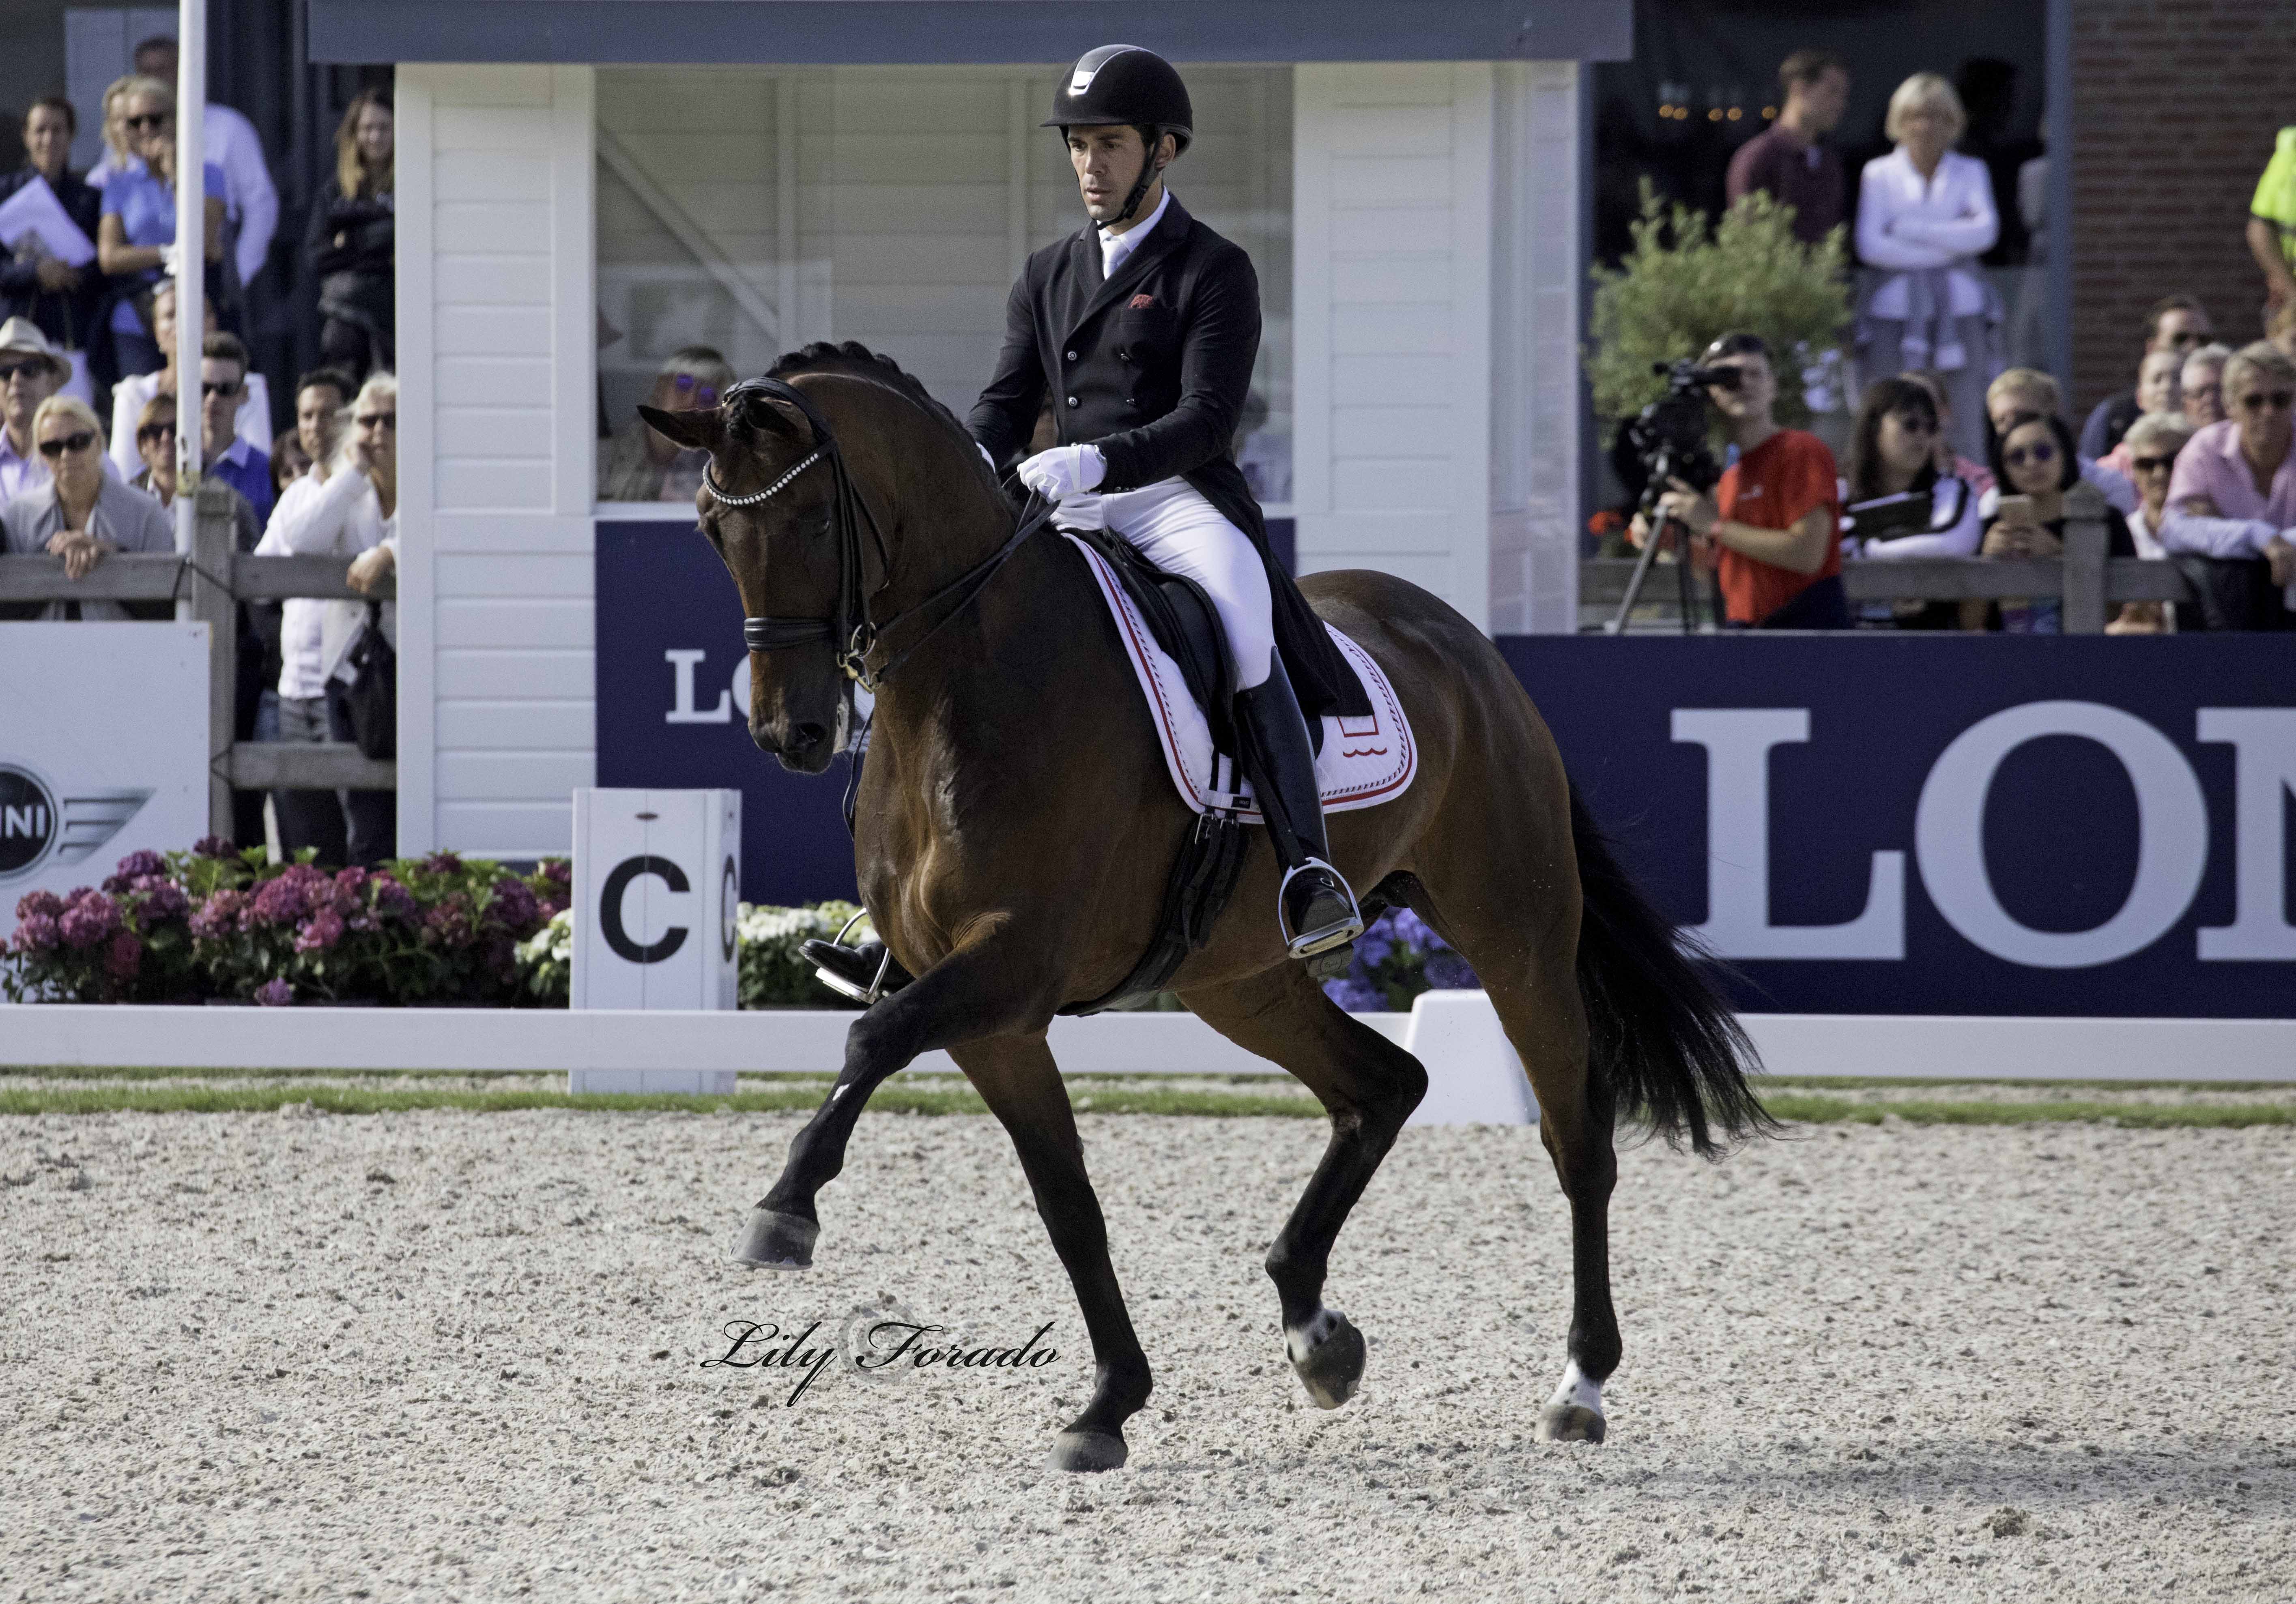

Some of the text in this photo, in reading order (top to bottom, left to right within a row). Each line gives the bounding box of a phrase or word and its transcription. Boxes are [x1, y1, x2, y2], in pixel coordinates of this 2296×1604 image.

[0, 804, 46, 838] NI
[600, 854, 690, 964] C
[721, 853, 736, 964] C
